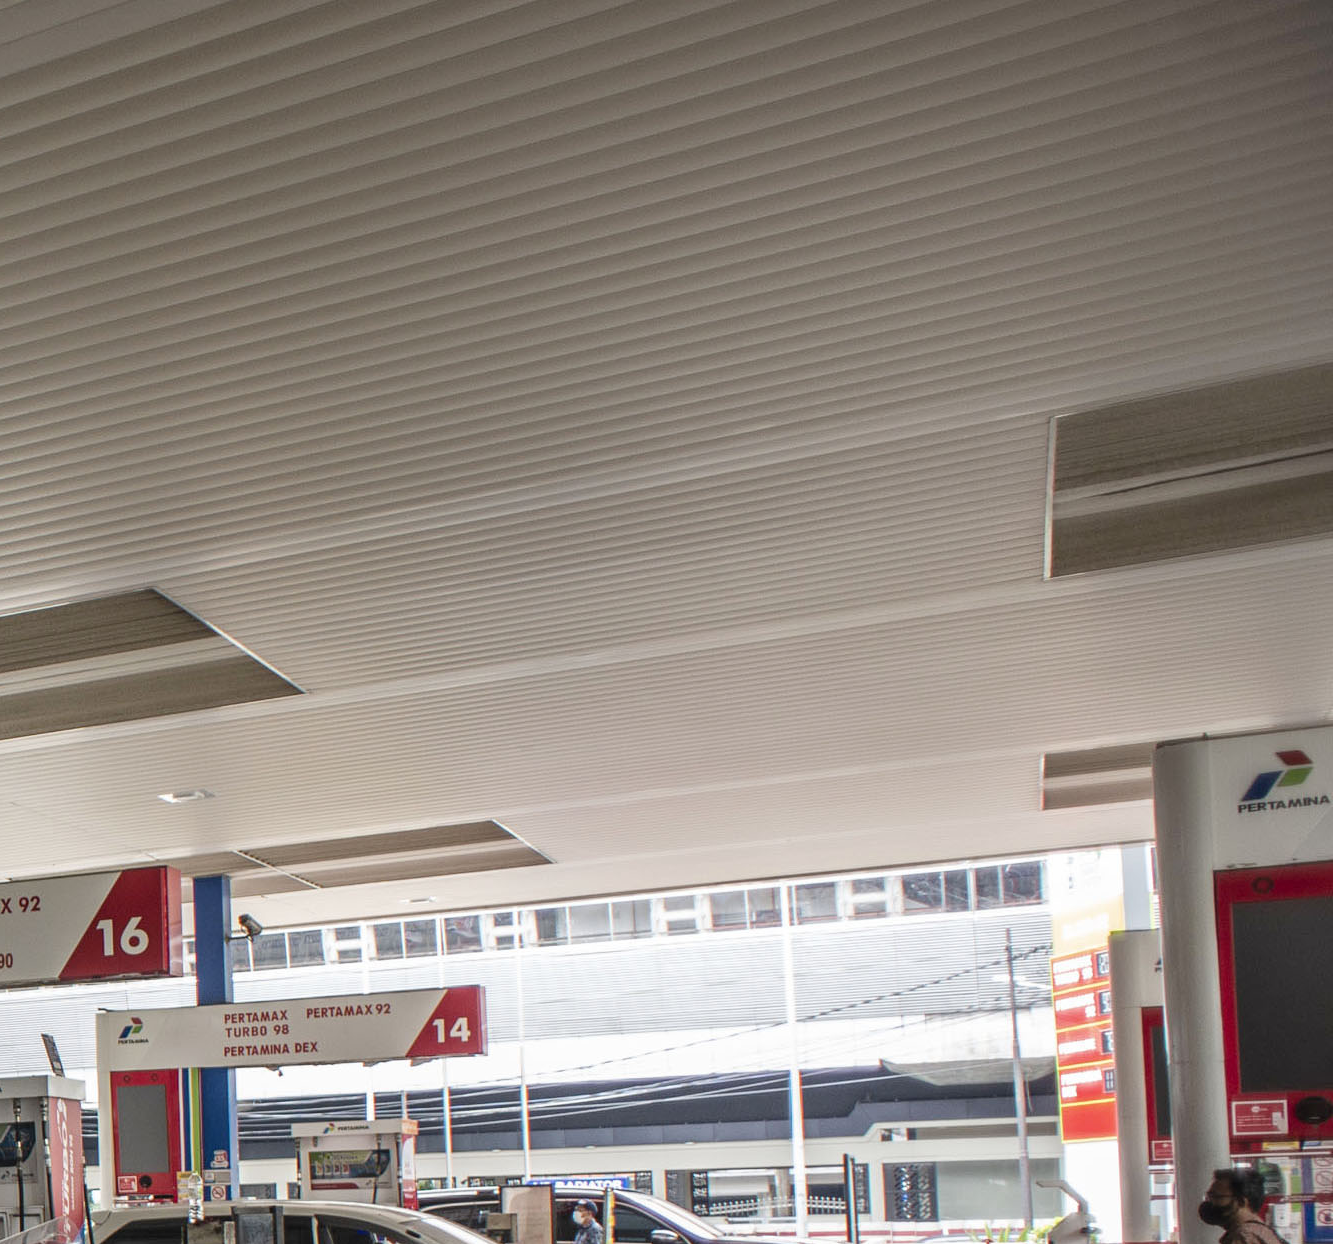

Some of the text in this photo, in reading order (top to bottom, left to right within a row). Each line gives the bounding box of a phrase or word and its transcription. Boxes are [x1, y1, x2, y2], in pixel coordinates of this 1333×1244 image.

[1238, 795, 1330, 814] PERTAMINA
[19, 895, 41, 913] 92
[96, 916, 149, 957] 16
[224, 1010, 289, 1025] PERTAMAX
[306, 1003, 392, 1019] PERTAMAX 92
[225, 1024, 290, 1038] TURBO 98
[433, 1017, 471, 1044] 14
[224, 1041, 319, 1057] PERTAMINA DEX
[555, 1179, 622, 1189] RADIATOR
